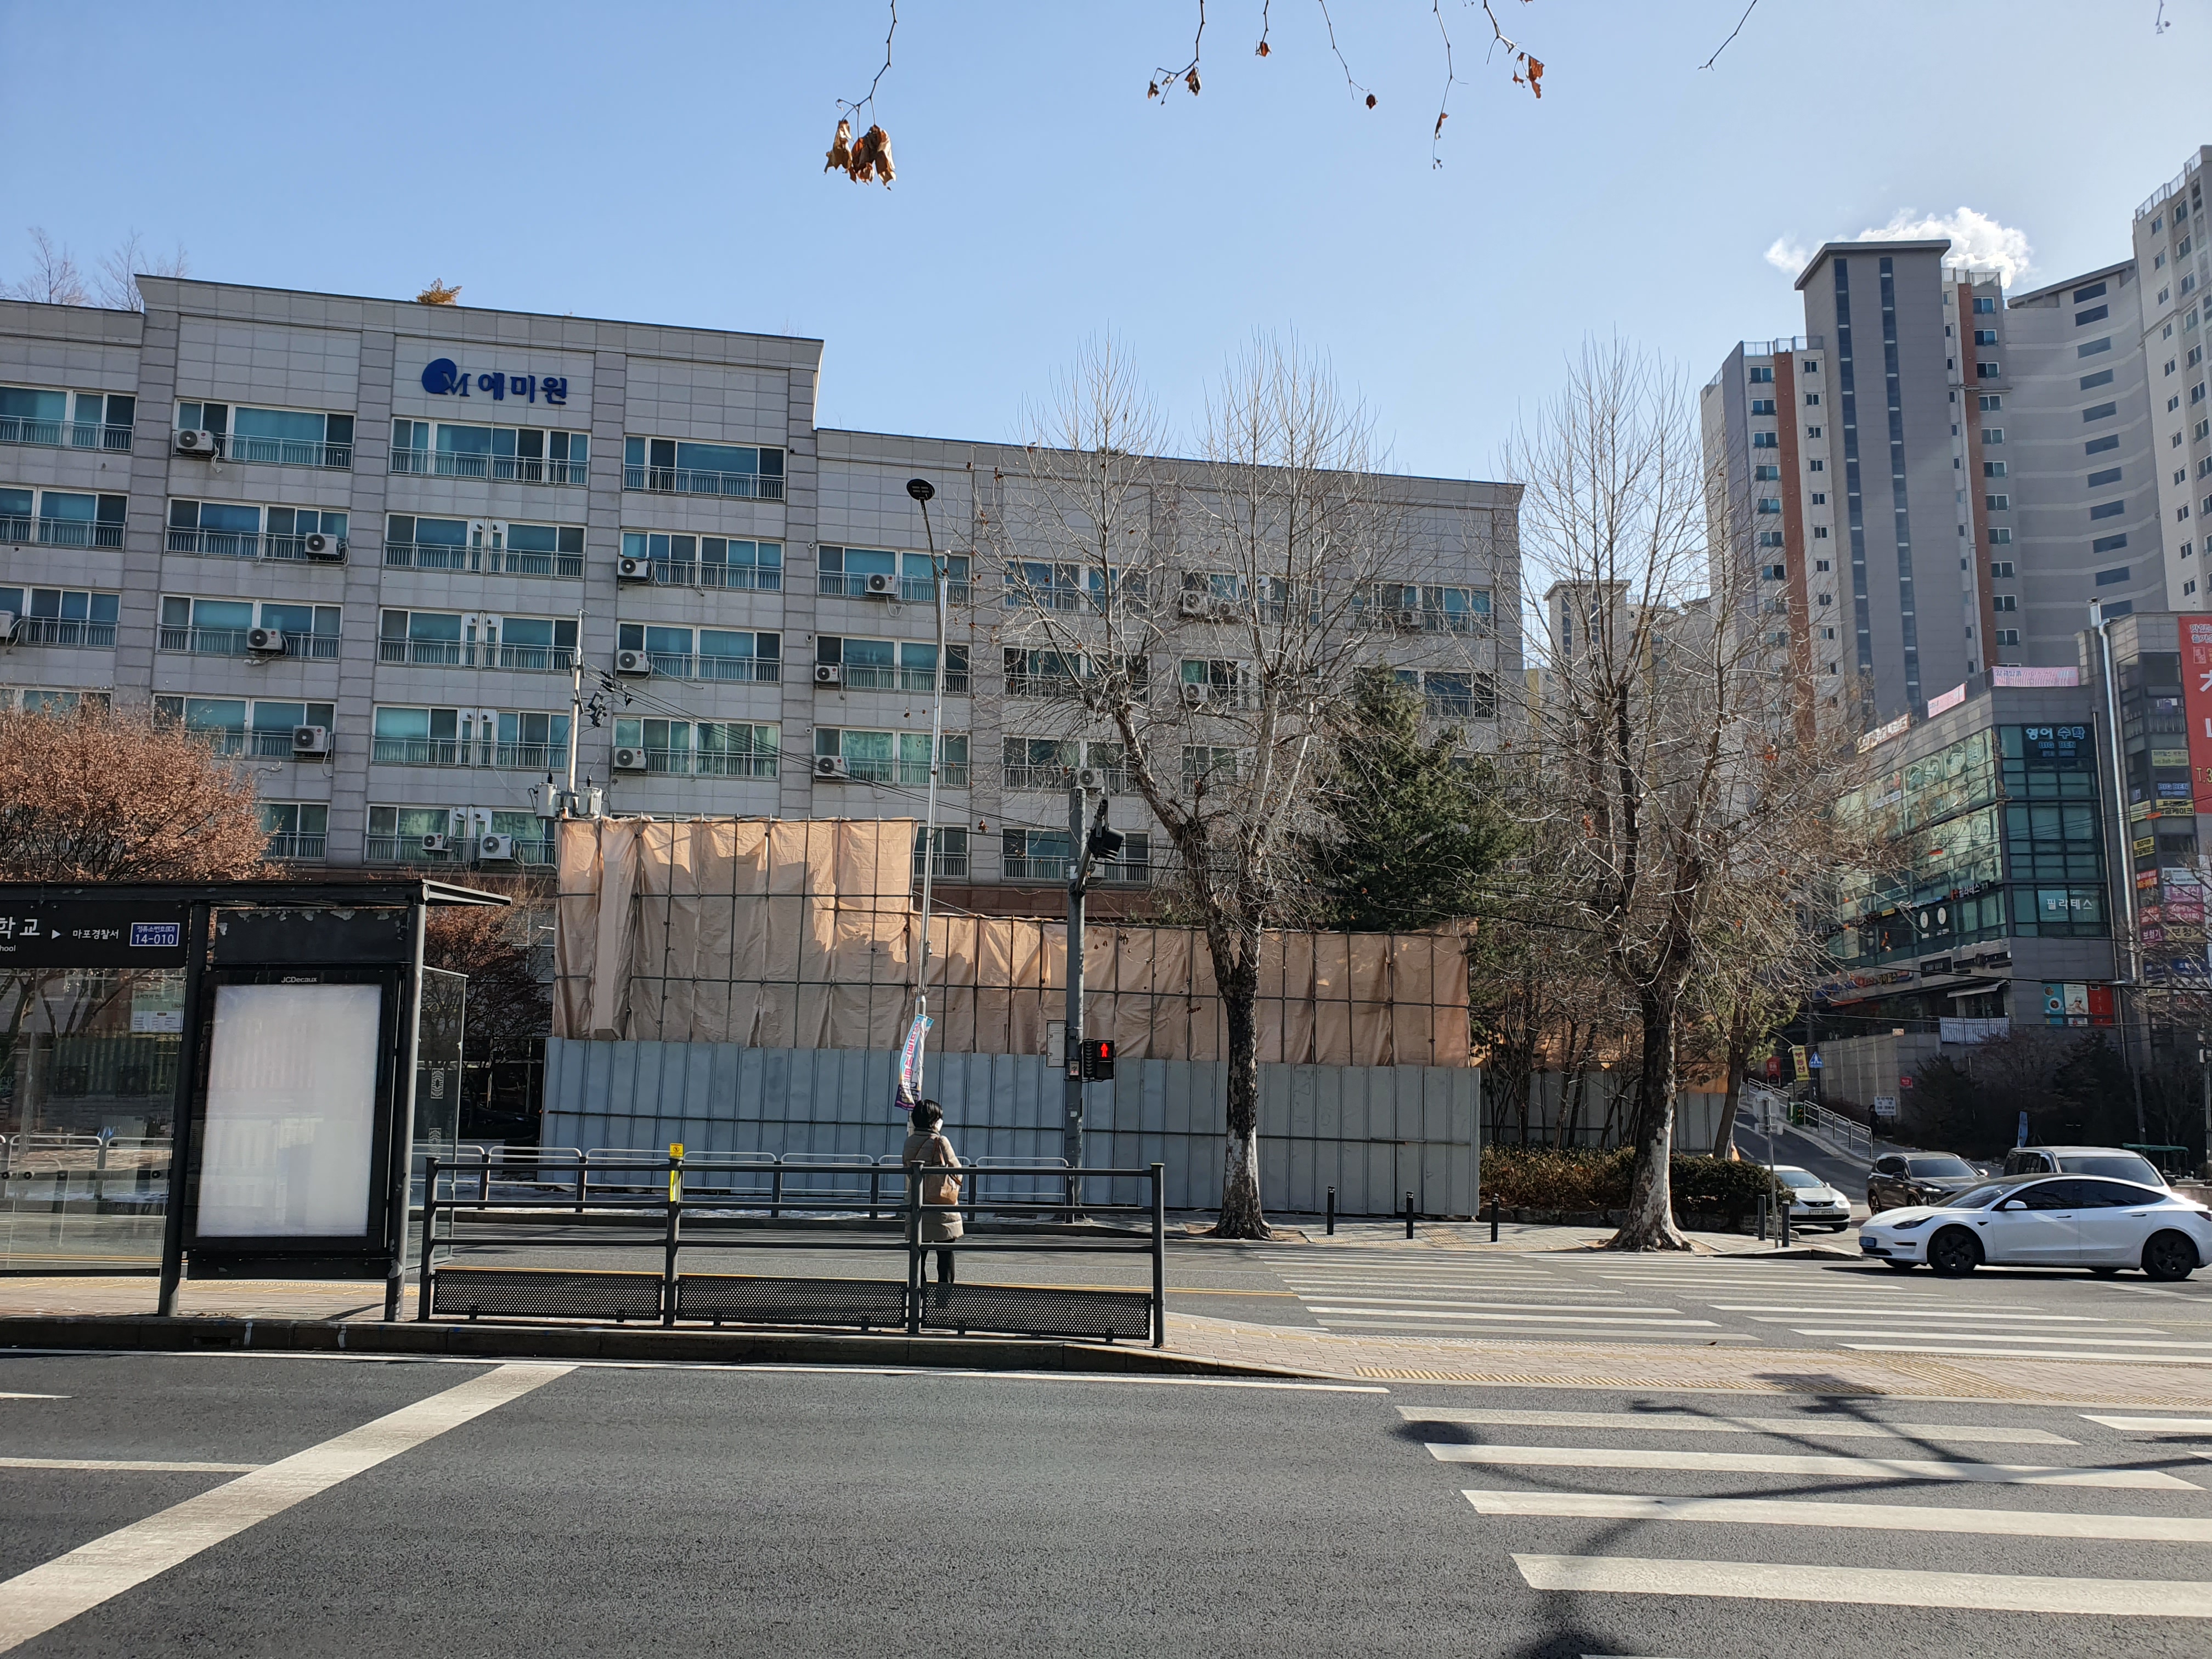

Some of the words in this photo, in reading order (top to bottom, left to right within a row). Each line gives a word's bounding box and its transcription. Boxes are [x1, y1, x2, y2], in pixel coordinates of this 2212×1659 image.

[478, 372, 567, 405] 예미원
[2026, 728, 2053, 740] 영어
[2057, 727, 2085, 740] 수학
[2046, 899, 2093, 910] 필라테스
[72, 929, 120, 940] 마포경찰서
[135, 934, 175, 944] 14-010
